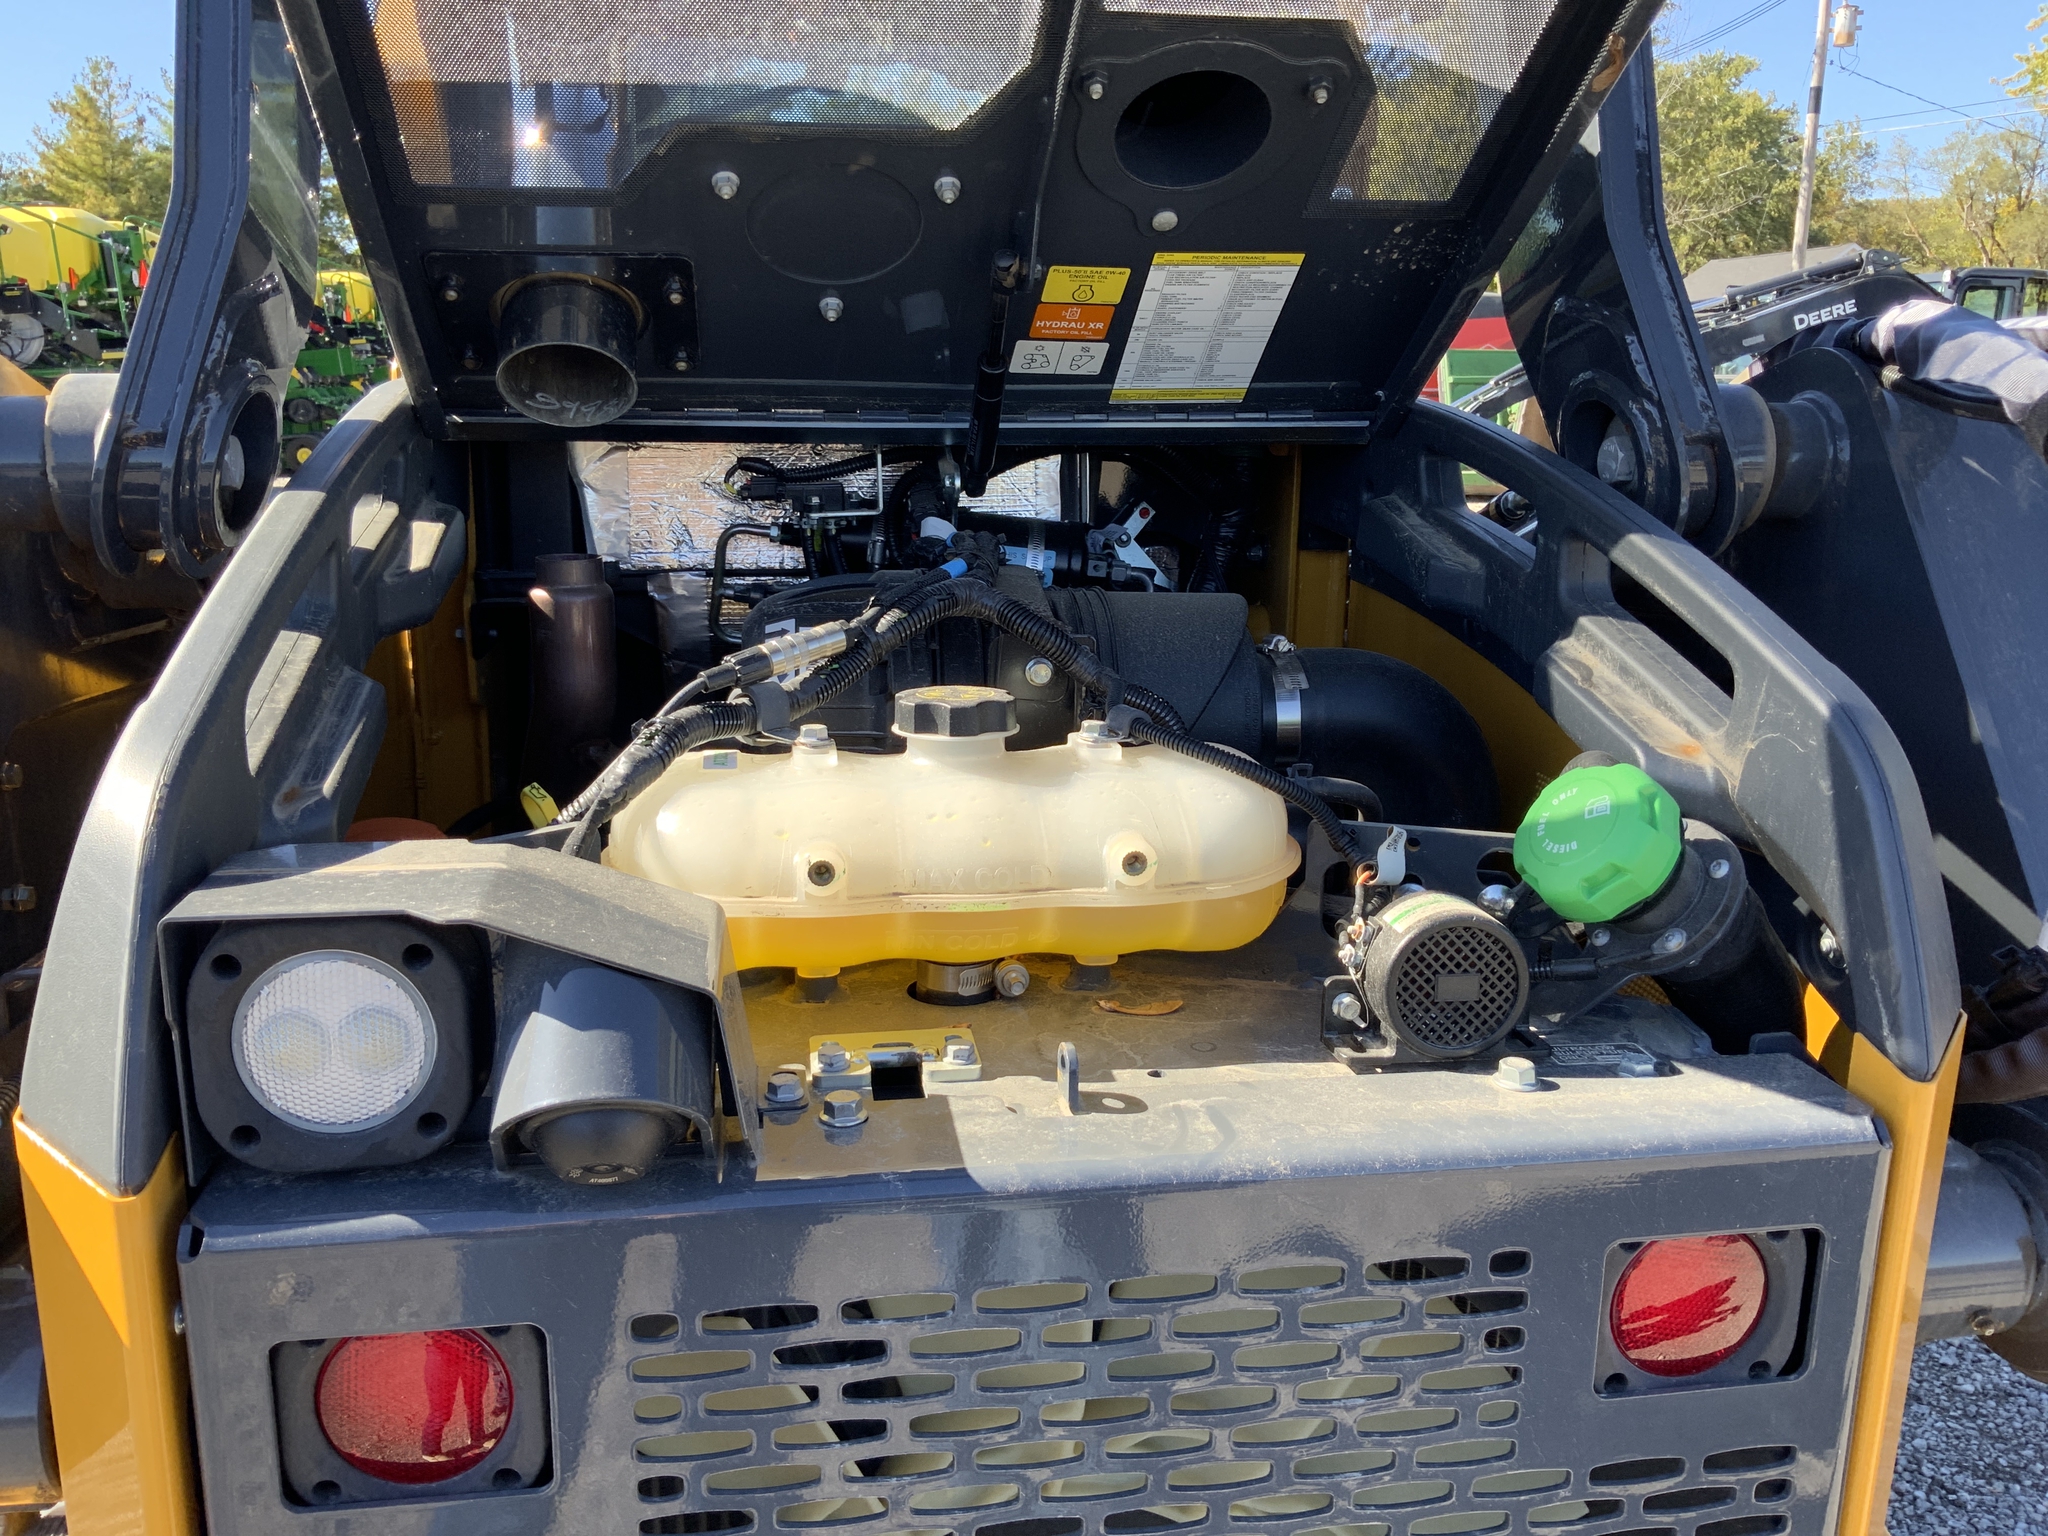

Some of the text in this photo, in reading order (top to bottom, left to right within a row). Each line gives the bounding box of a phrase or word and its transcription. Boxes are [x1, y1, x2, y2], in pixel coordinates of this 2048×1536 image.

[1036, 320, 1086, 329] HYDRAU
[1793, 299, 1858, 330] DEERE
[1537, 786, 1579, 854] DIESEL FUEL ONLY
[902, 864, 1053, 890] MAX COLD
[945, 933, 1019, 951] COLD
